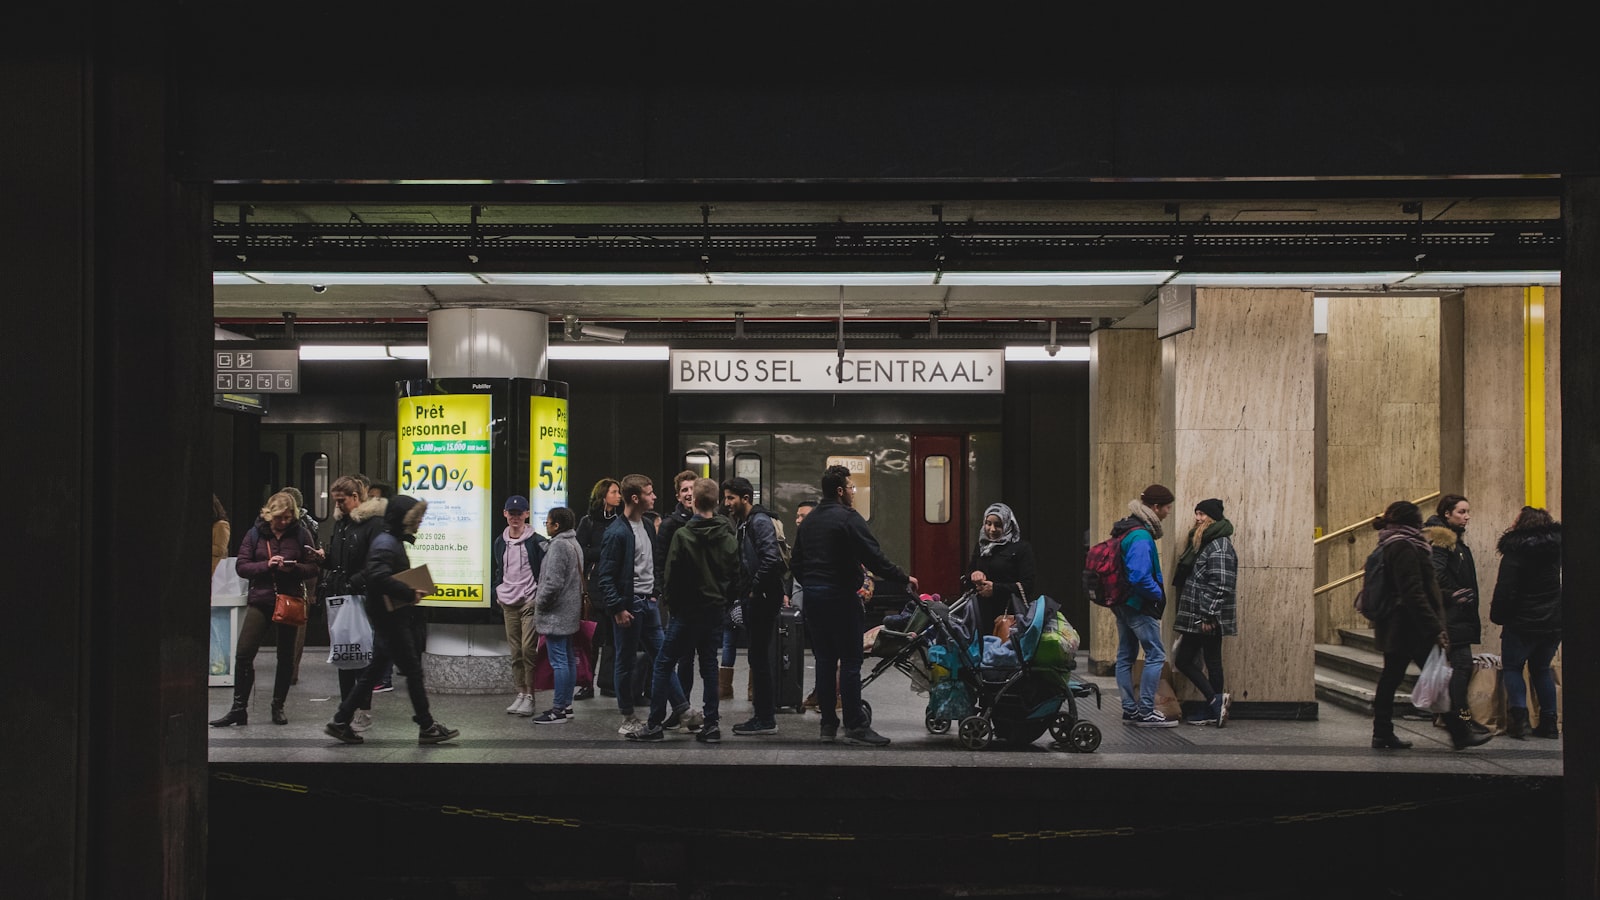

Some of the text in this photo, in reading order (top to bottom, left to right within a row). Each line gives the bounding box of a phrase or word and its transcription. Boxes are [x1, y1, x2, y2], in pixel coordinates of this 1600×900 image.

[680, 359, 801, 383] BRUSSEL
[226, 379, 290, 387] 1 2 5 6
[416, 404, 444, 419] Prêt
[402, 421, 467, 440] personnel
[402, 460, 473, 494] 5,20%
[434, 533, 446, 541] 026
[333, 643, 361, 653] ETTER
[333, 652, 373, 661] OGETHE
